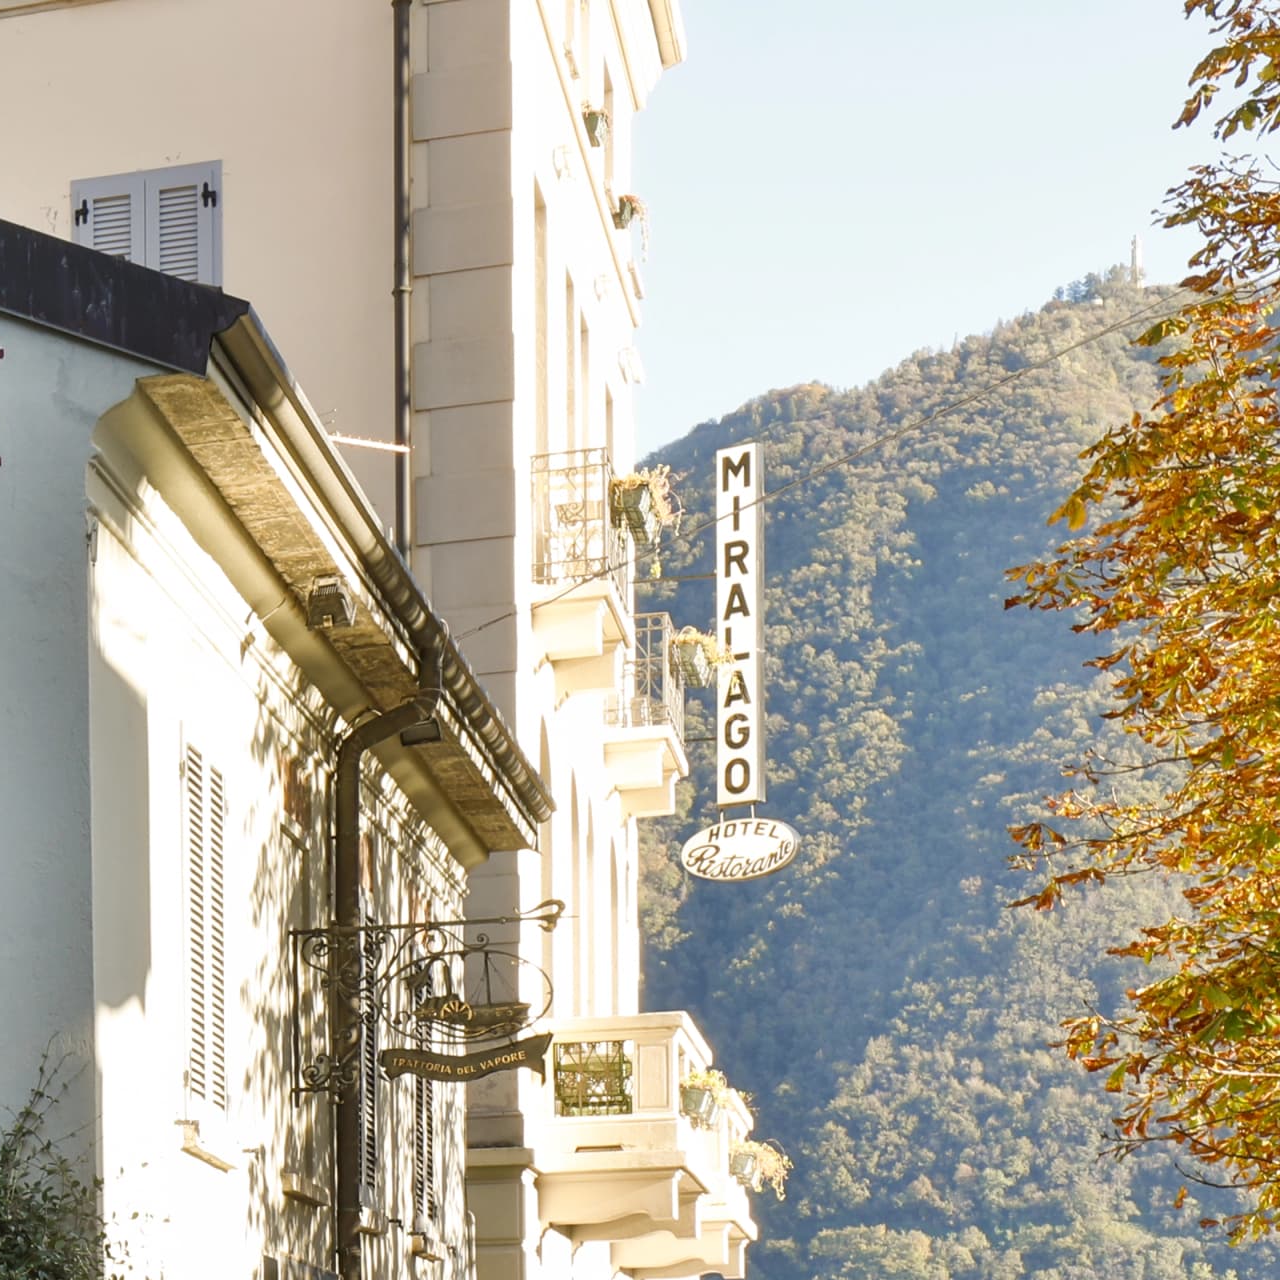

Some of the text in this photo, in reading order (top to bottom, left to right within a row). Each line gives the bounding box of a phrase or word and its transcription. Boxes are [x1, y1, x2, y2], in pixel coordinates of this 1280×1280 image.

[721, 451, 751, 795] MIRALAGO
[708, 821, 779, 842] HOTEL
[686, 844, 792, 877] Ristorante
[392, 1050, 527, 1075] TRATTORIA DEL VAPORE
